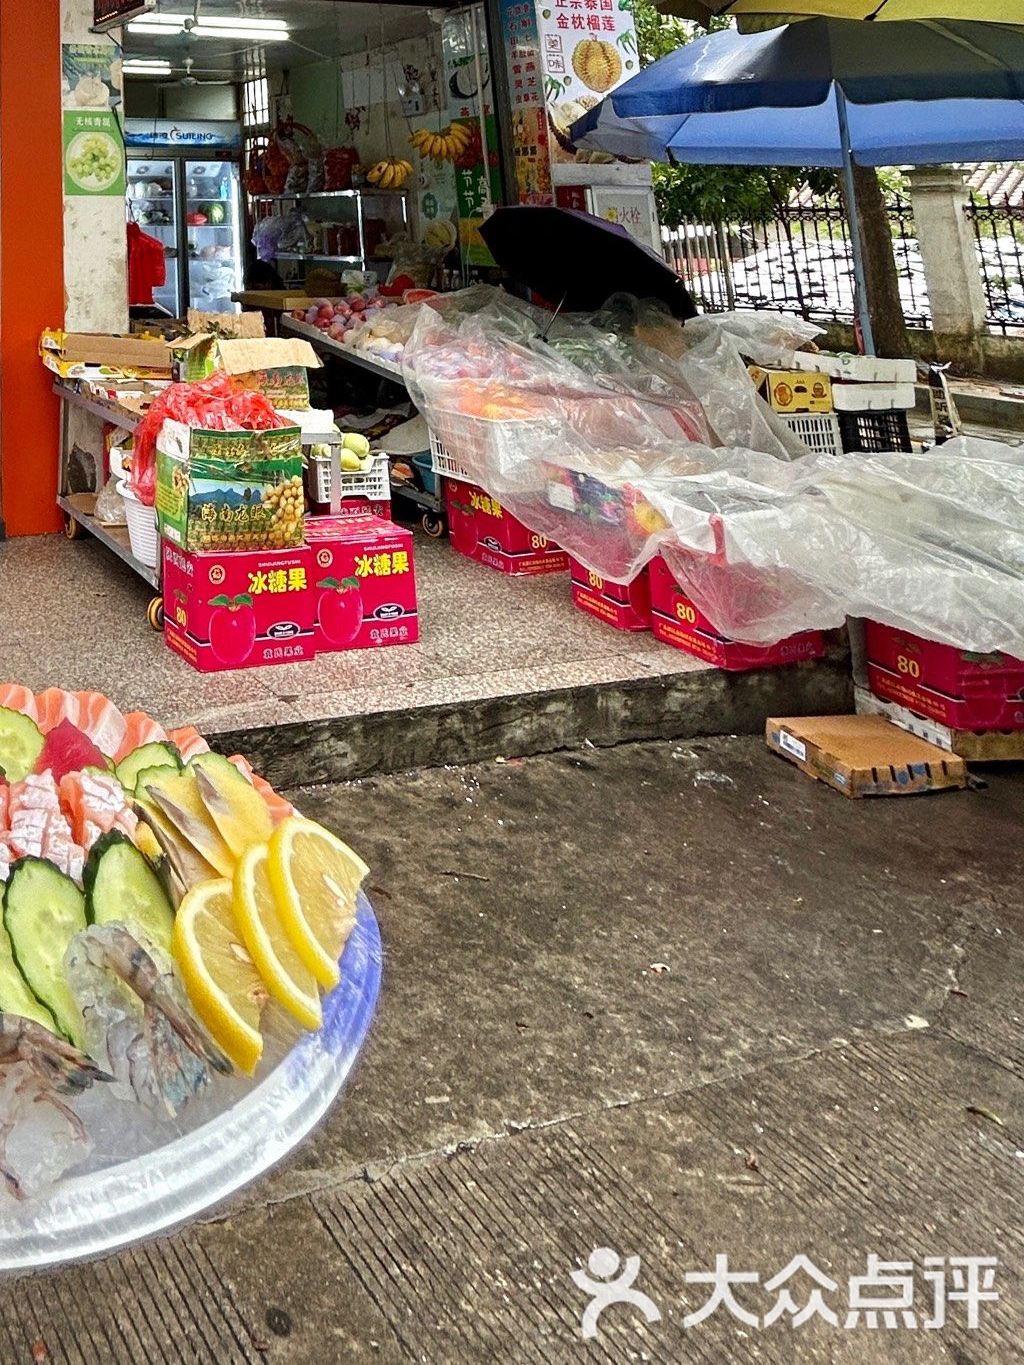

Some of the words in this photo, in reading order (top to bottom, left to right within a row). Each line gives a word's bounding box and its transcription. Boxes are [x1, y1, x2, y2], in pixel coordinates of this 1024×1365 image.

[556, 13, 616, 32] 金枕榴莲
[201, 503, 266, 523] 海南龙眼
[531, 535, 546, 549] 80
[354, 551, 409, 578] 冰糖果
[247, 567, 308, 595] 冰糖果
[588, 571, 604, 590] 80
[676, 602, 695, 624] 80
[897, 655, 920, 678] 80
